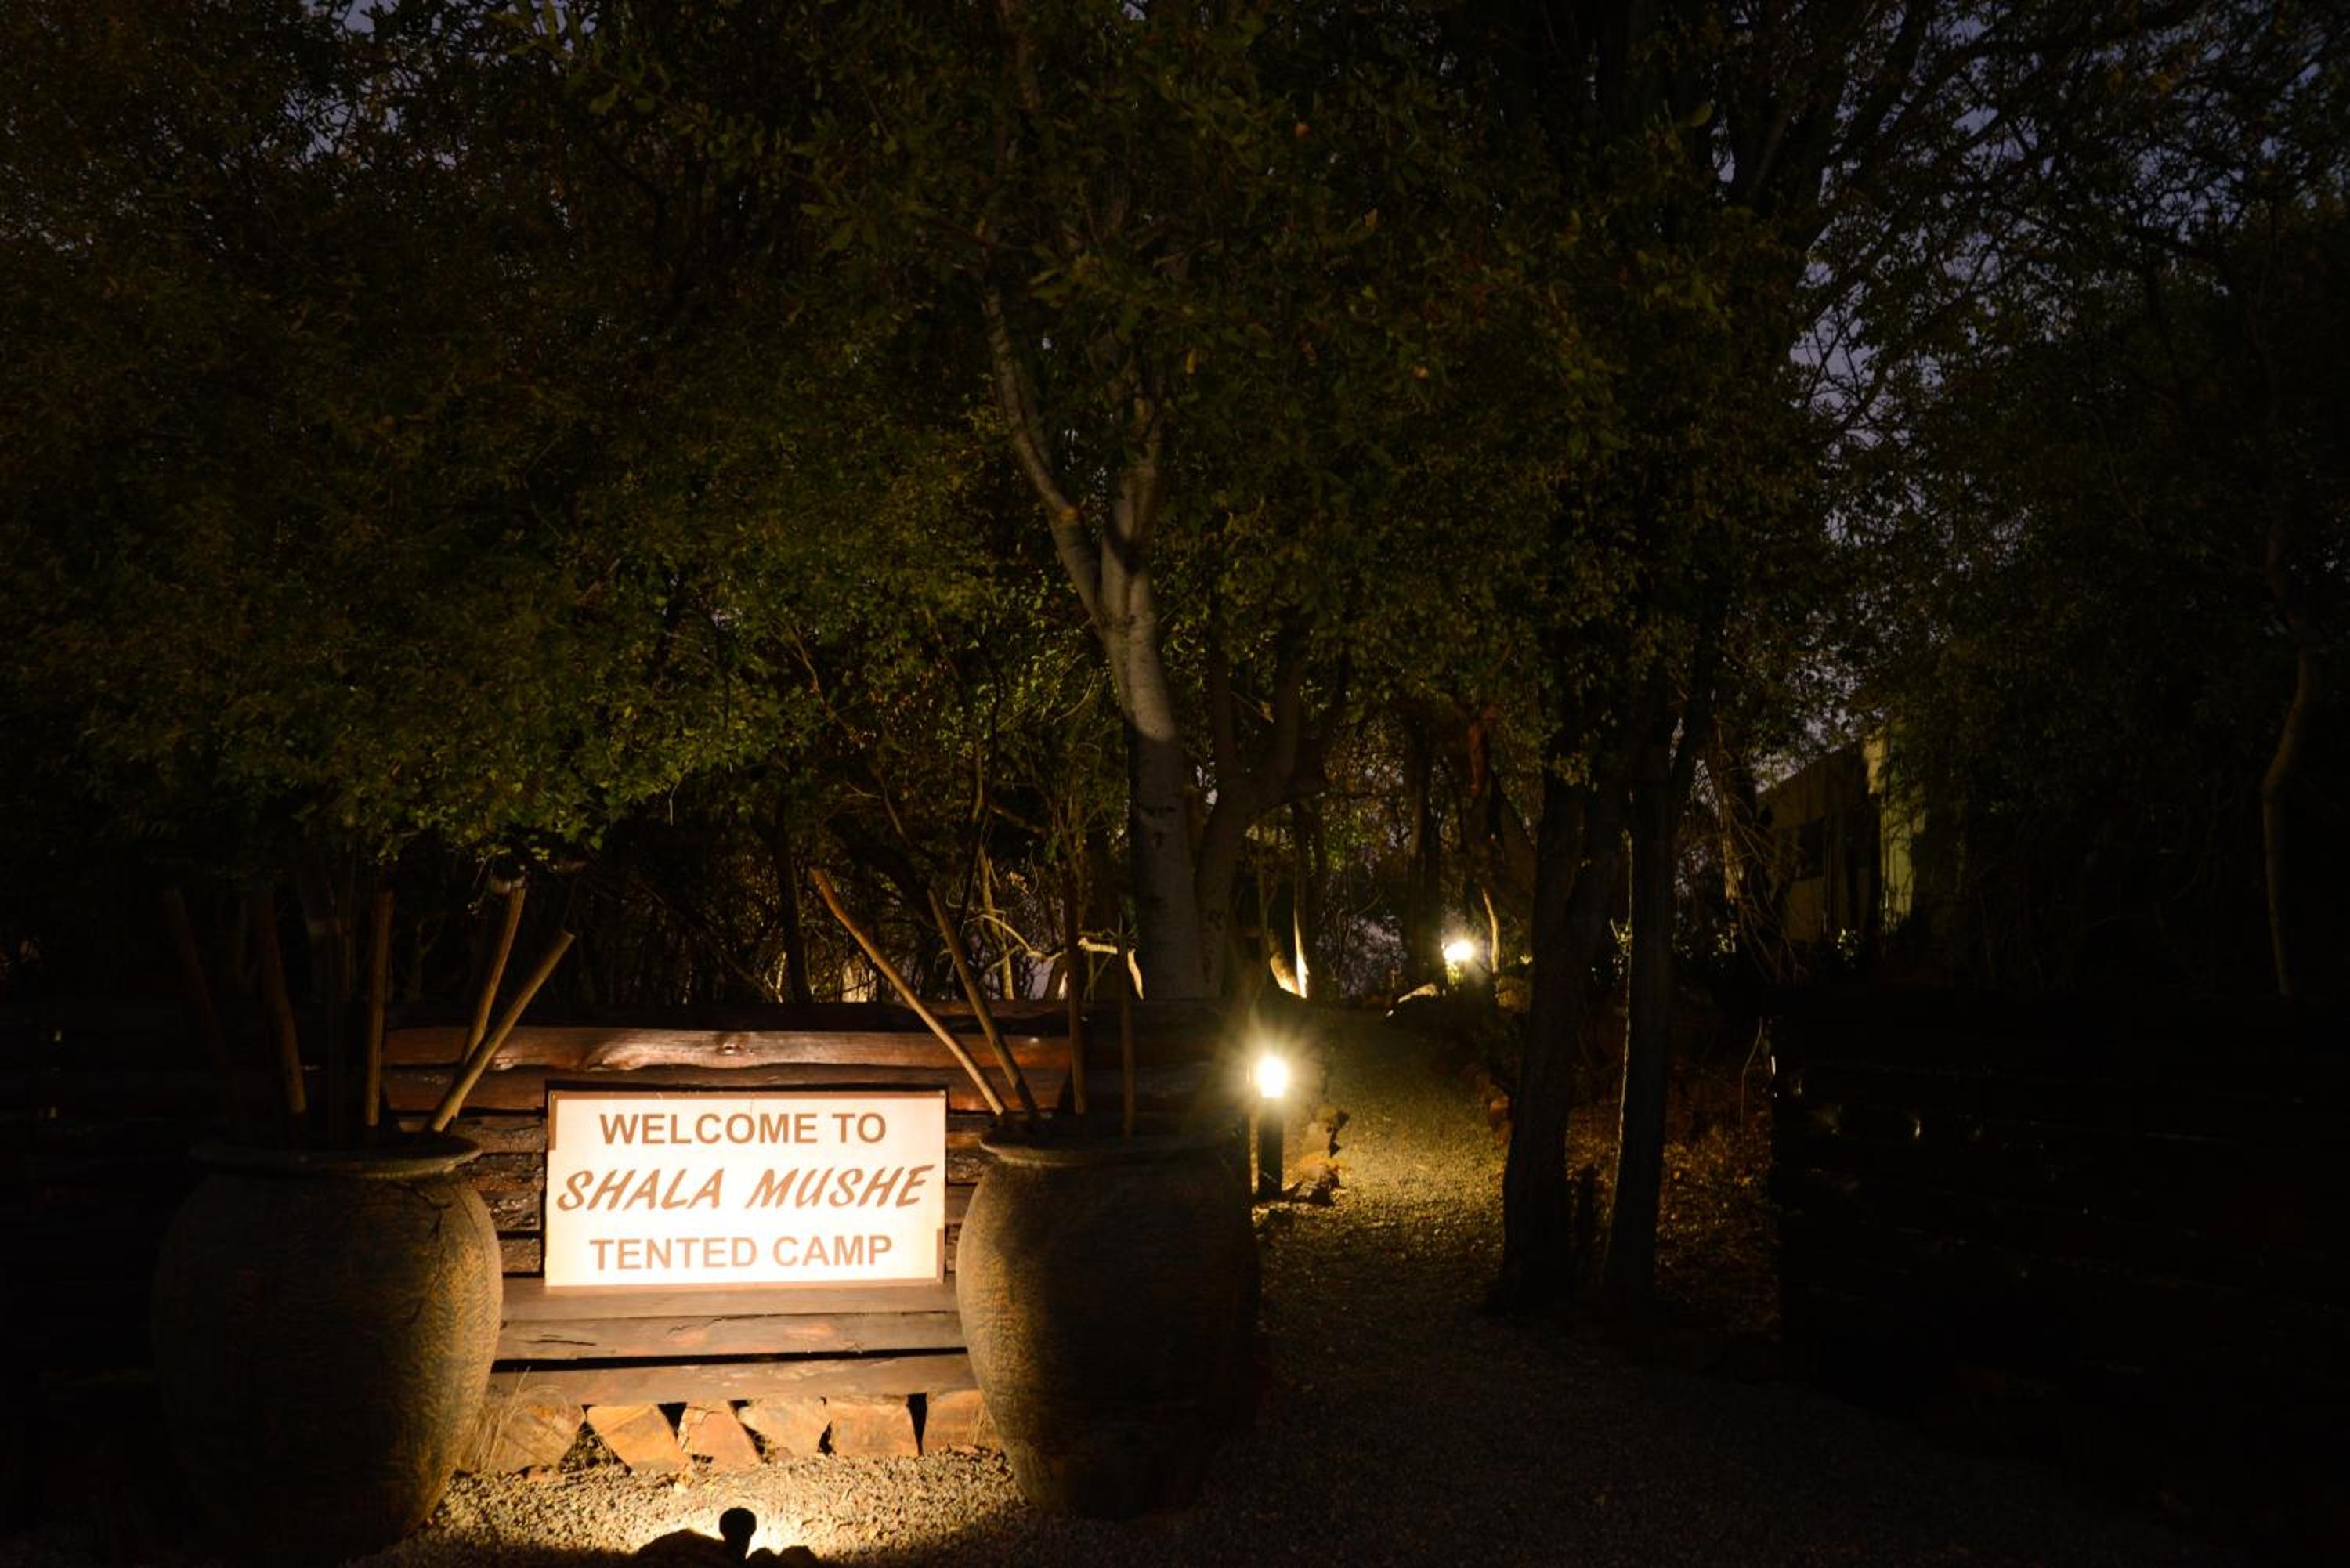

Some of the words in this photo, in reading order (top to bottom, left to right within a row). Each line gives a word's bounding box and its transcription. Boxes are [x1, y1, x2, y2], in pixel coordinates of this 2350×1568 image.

[599, 1112, 818, 1145] WELCOME
[832, 1112, 887, 1144] TO
[555, 1169, 724, 1212] SHALA
[745, 1164, 935, 1209] MUSHE
[590, 1237, 757, 1270] TENTED
[773, 1234, 892, 1266] CAMP
